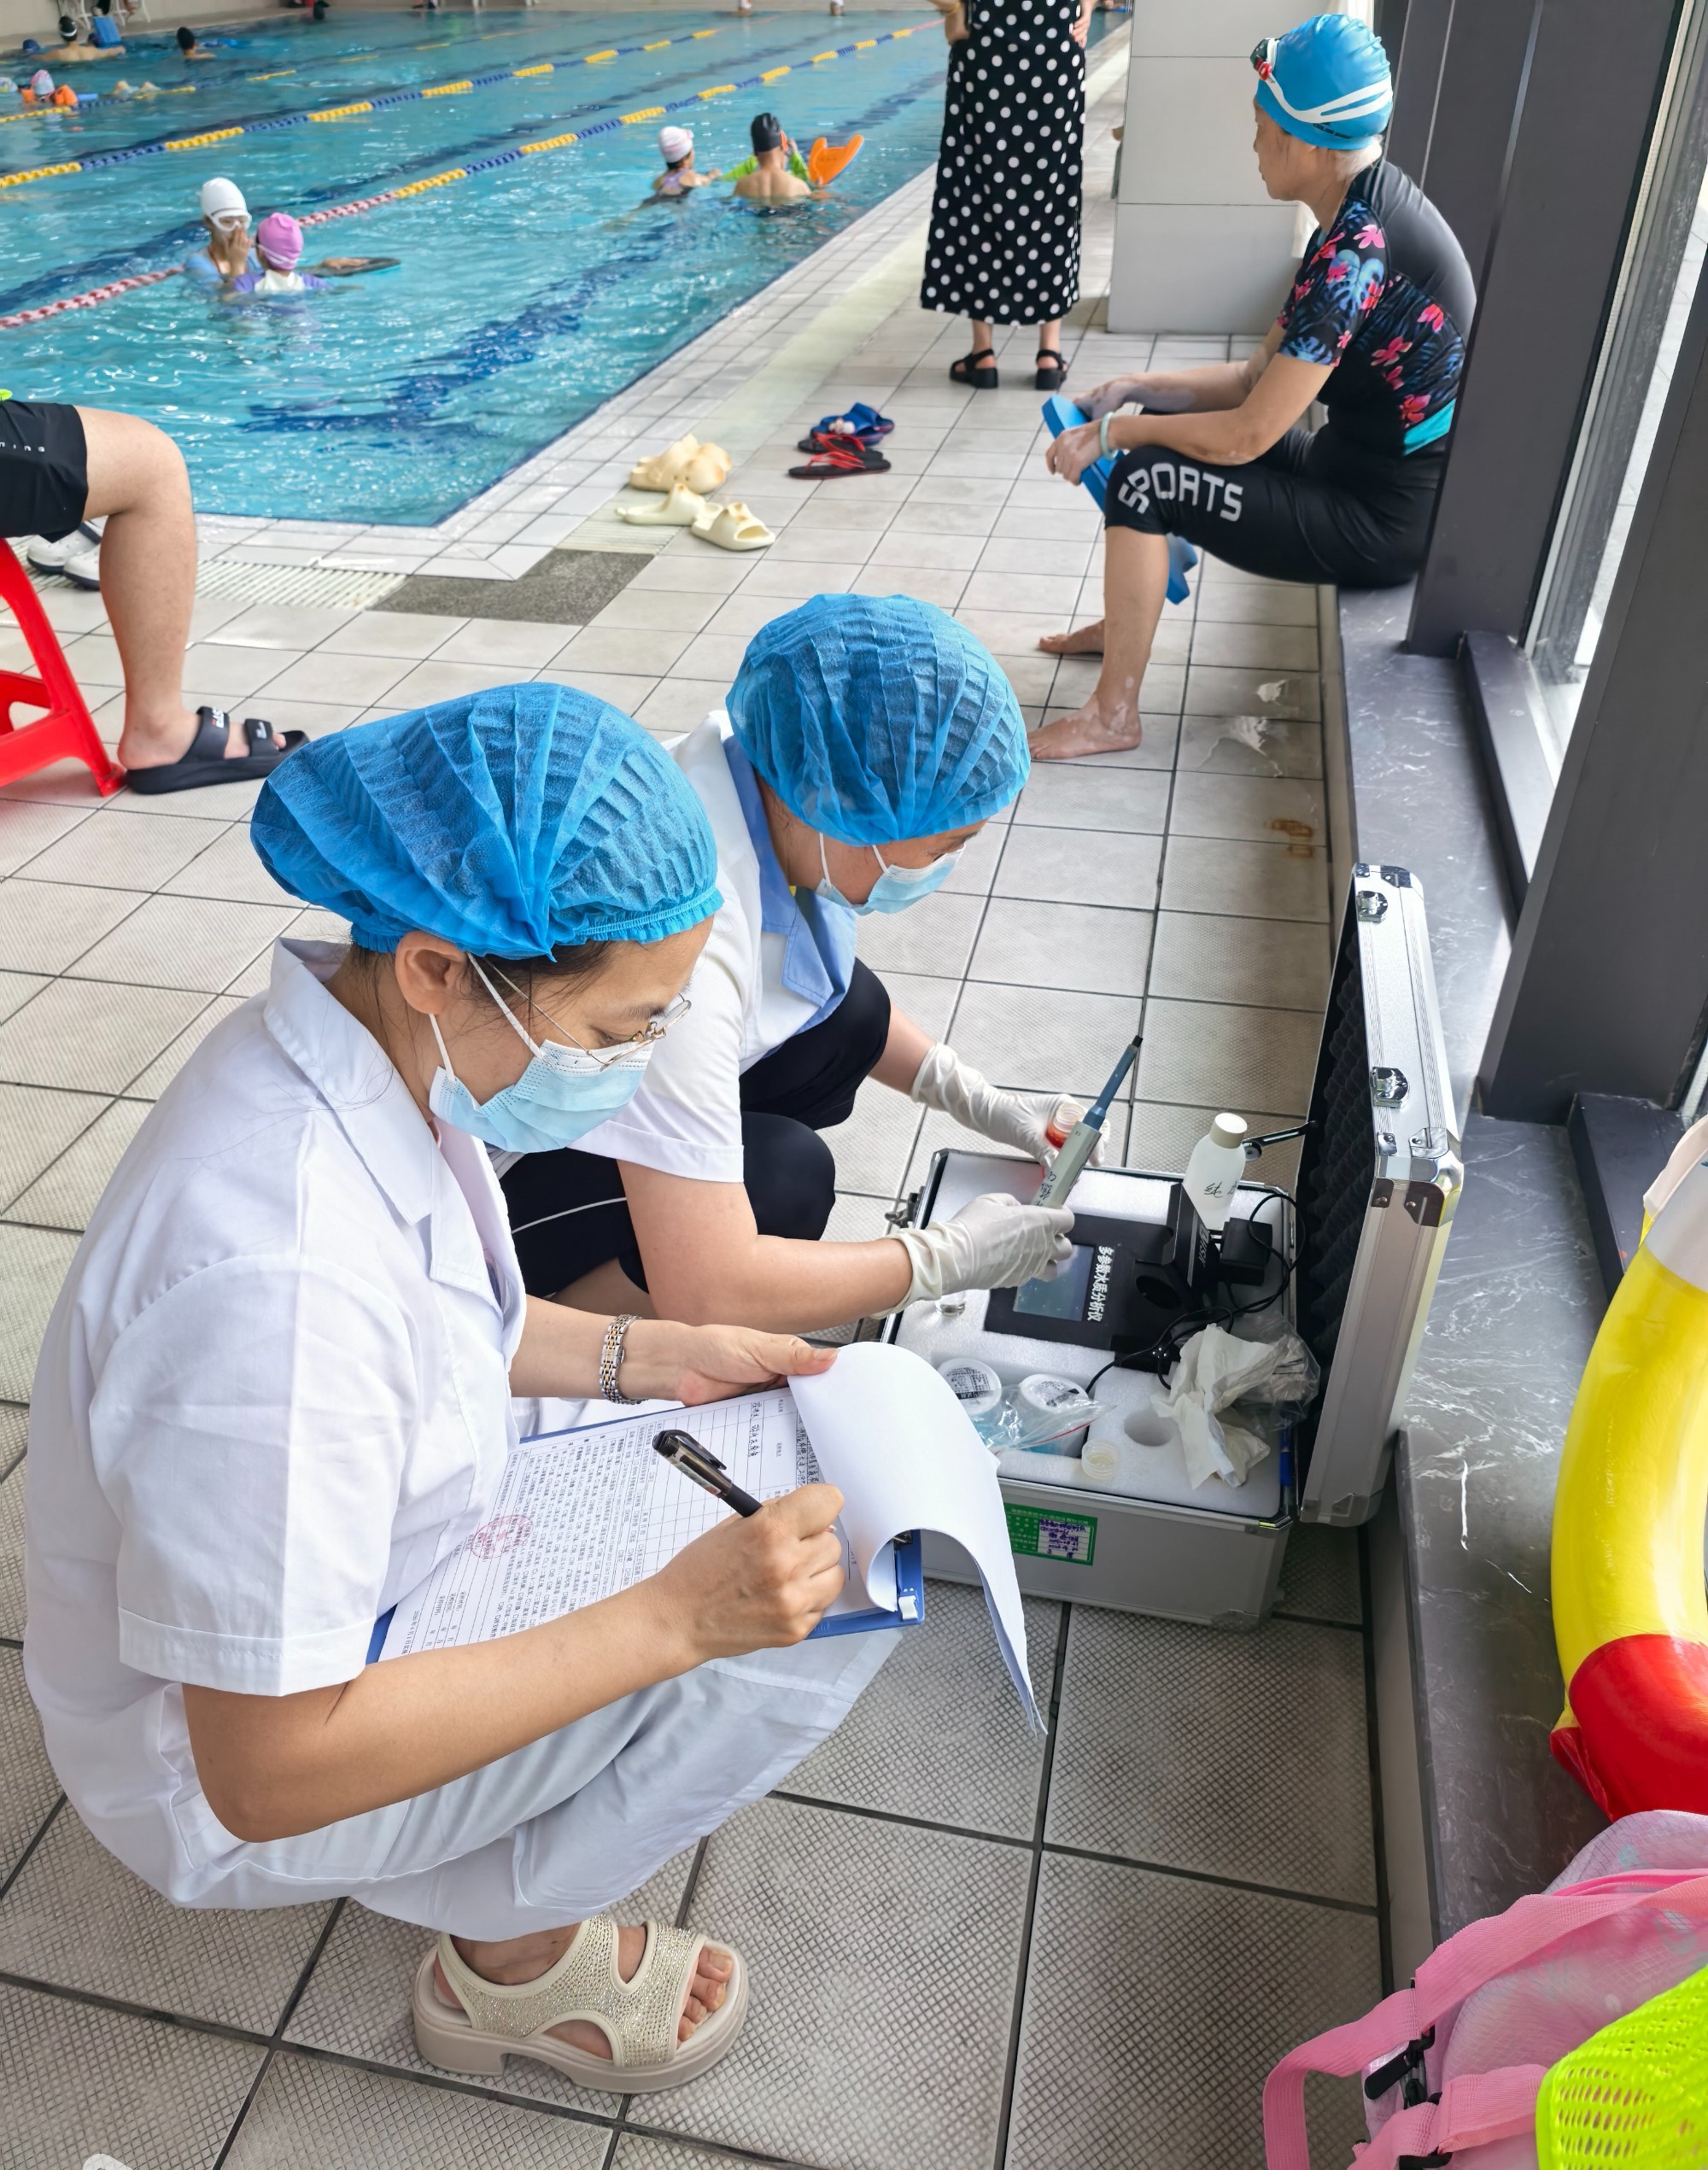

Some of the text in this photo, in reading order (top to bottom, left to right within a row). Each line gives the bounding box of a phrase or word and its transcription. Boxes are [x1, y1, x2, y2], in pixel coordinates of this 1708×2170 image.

[1118, 462, 1243, 522] SPORTS
[1086, 1245, 1114, 1322] 多参数水质分析仪
